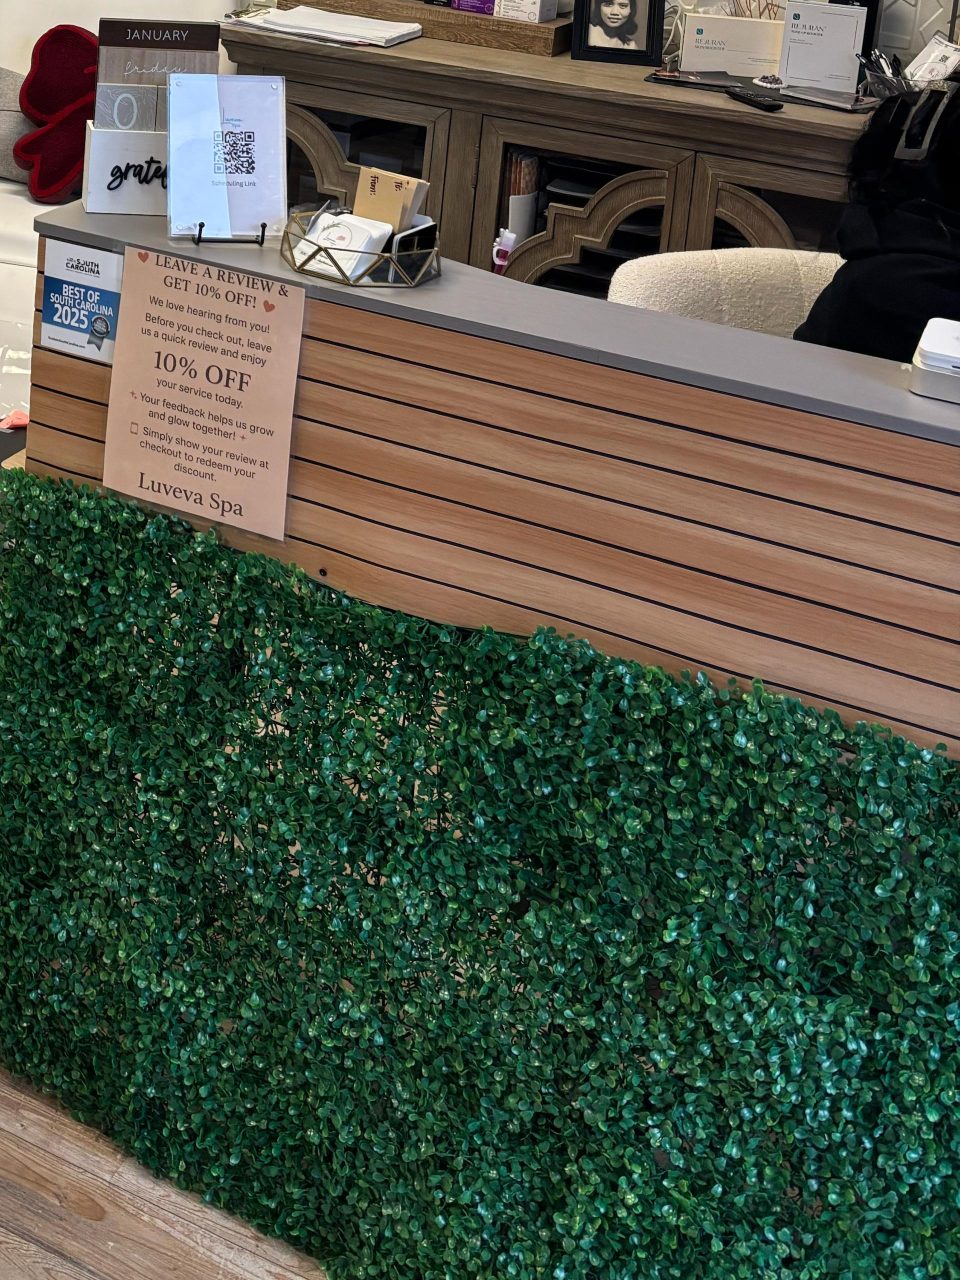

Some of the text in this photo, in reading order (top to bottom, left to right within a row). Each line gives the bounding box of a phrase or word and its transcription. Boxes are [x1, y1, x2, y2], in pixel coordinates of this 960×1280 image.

[126, 29, 189, 40] JANUARY
[65, 262, 100, 275] CAROLINA
[155, 255, 289, 297] LEAVE A REVIEW &
[50, 293, 113, 317] SOUTH CAROLINA
[63, 284, 100, 303] BEST OF
[164, 275, 257, 308] GET 10% OFF!
[53, 304, 88, 329] 2025
[146, 312, 272, 353] Before you check out, leave
[149, 296, 270, 334] We love hearing from you!
[142, 327, 152, 336] us
[161, 331, 186, 345] quick
[188, 339, 218, 354] review
[220, 346, 238, 359] and
[241, 353, 267, 368] enjoy
[154, 350, 252, 393] 10% OFF
[156, 378, 244, 409] your service today.
[140, 392, 274, 437] Your feedback helps us grow
[149, 410, 236, 440] and glow together!
[140, 440, 256, 479] checkout to redeem your
[143, 426, 269, 469] Simply show your review at
[174, 462, 217, 482] discount.
[138, 472, 244, 517] Luveva Spa
